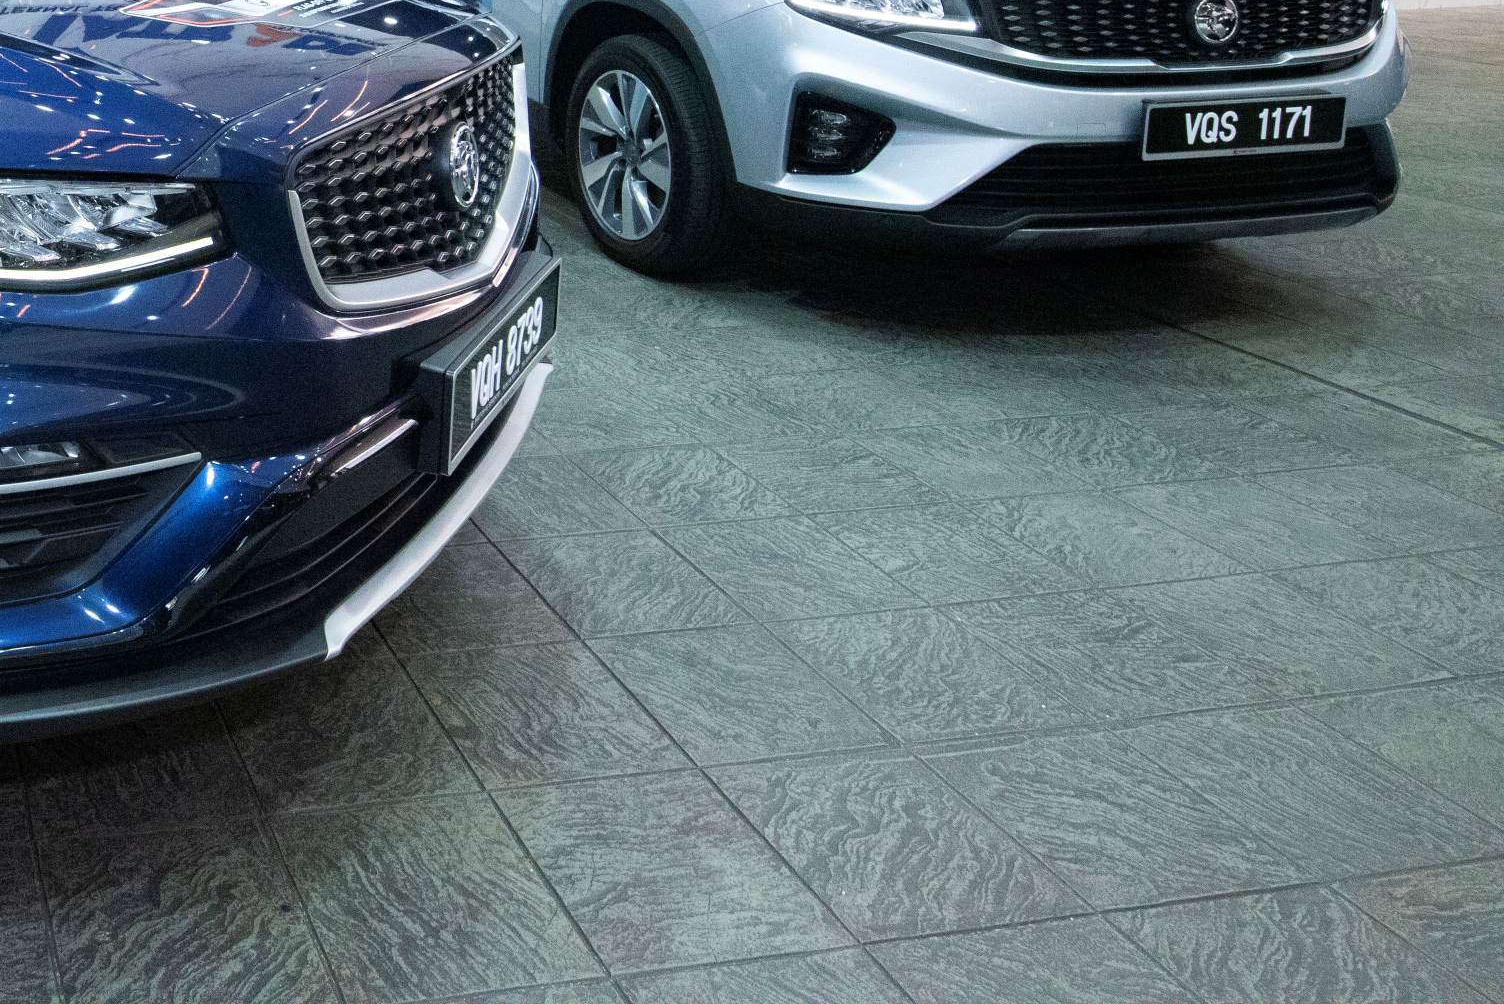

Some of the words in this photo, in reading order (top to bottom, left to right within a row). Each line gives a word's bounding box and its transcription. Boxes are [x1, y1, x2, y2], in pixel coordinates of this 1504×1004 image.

[1185, 110, 1239, 145] VQS
[1259, 106, 1313, 140] 1171
[506, 296, 544, 376] 8739
